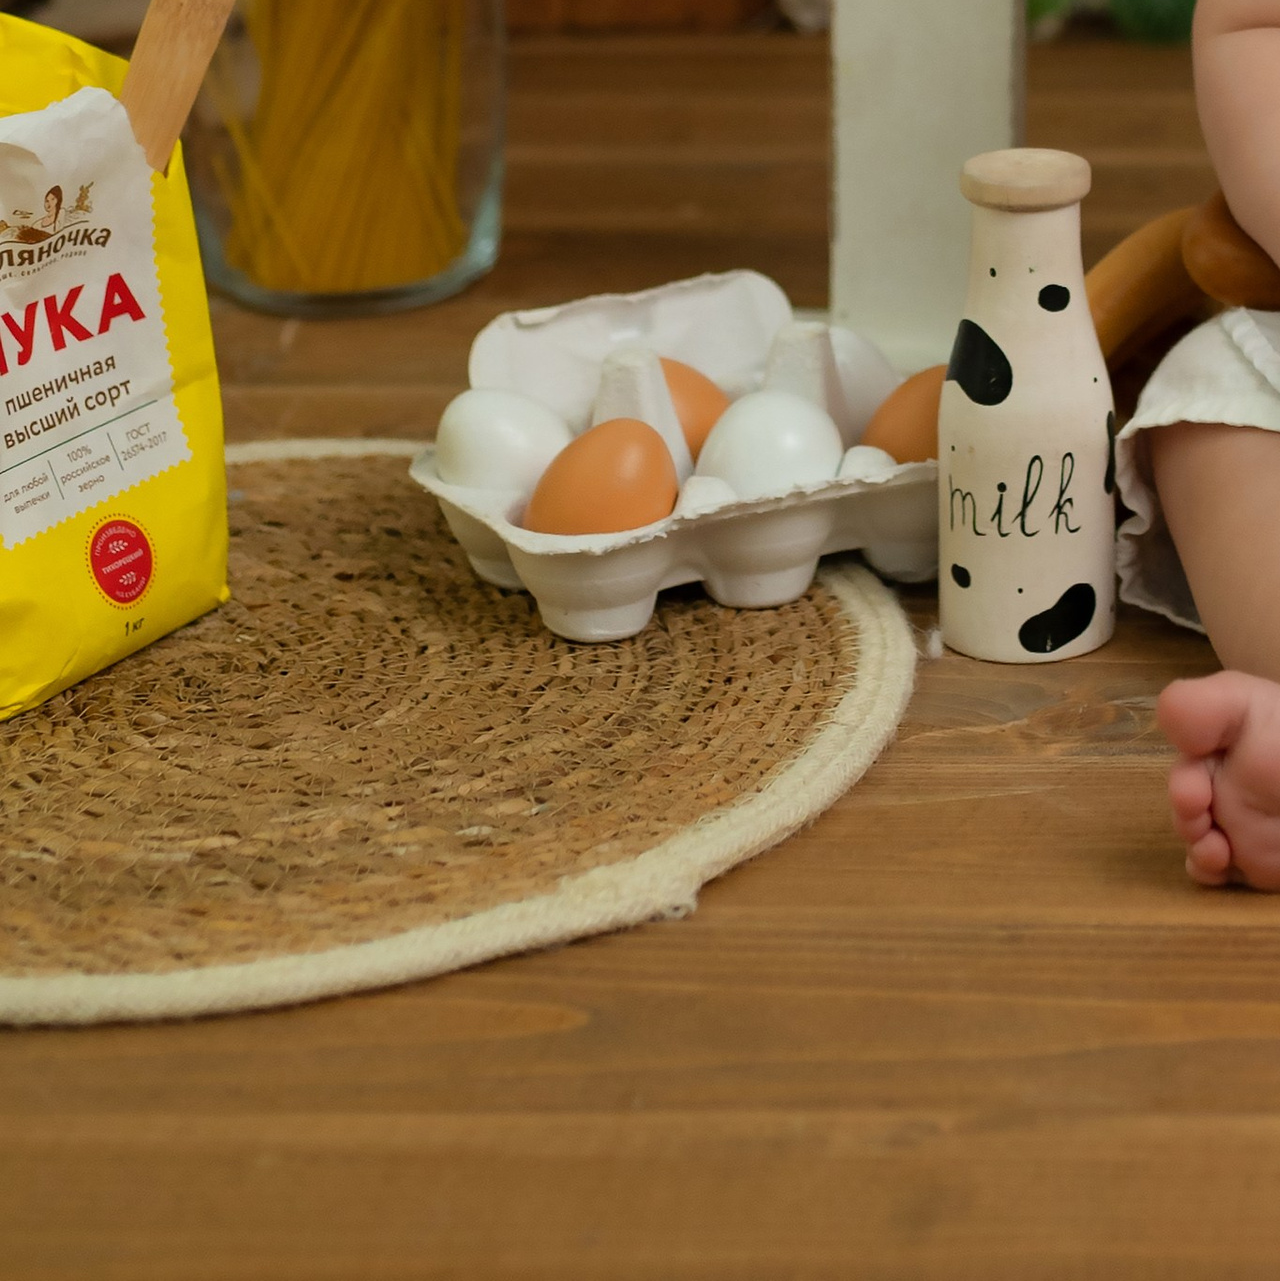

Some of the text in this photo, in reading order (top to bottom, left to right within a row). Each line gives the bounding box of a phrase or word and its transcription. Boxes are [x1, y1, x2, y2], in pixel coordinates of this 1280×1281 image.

[0, 272, 147, 376] УКА
[4, 355, 116, 416] пшеничная
[3, 379, 131, 449] высший сорт
[125, 422, 151, 443] ГОСТ
[66, 444, 93, 464] 100%
[59, 454, 112, 486] российское
[77, 474, 106, 493] зерно
[3, 472, 49, 503] для любой
[14, 491, 51, 514] выпечки
[948, 451, 1082, 538] milk
[125, 617, 145, 637] 1 кг
